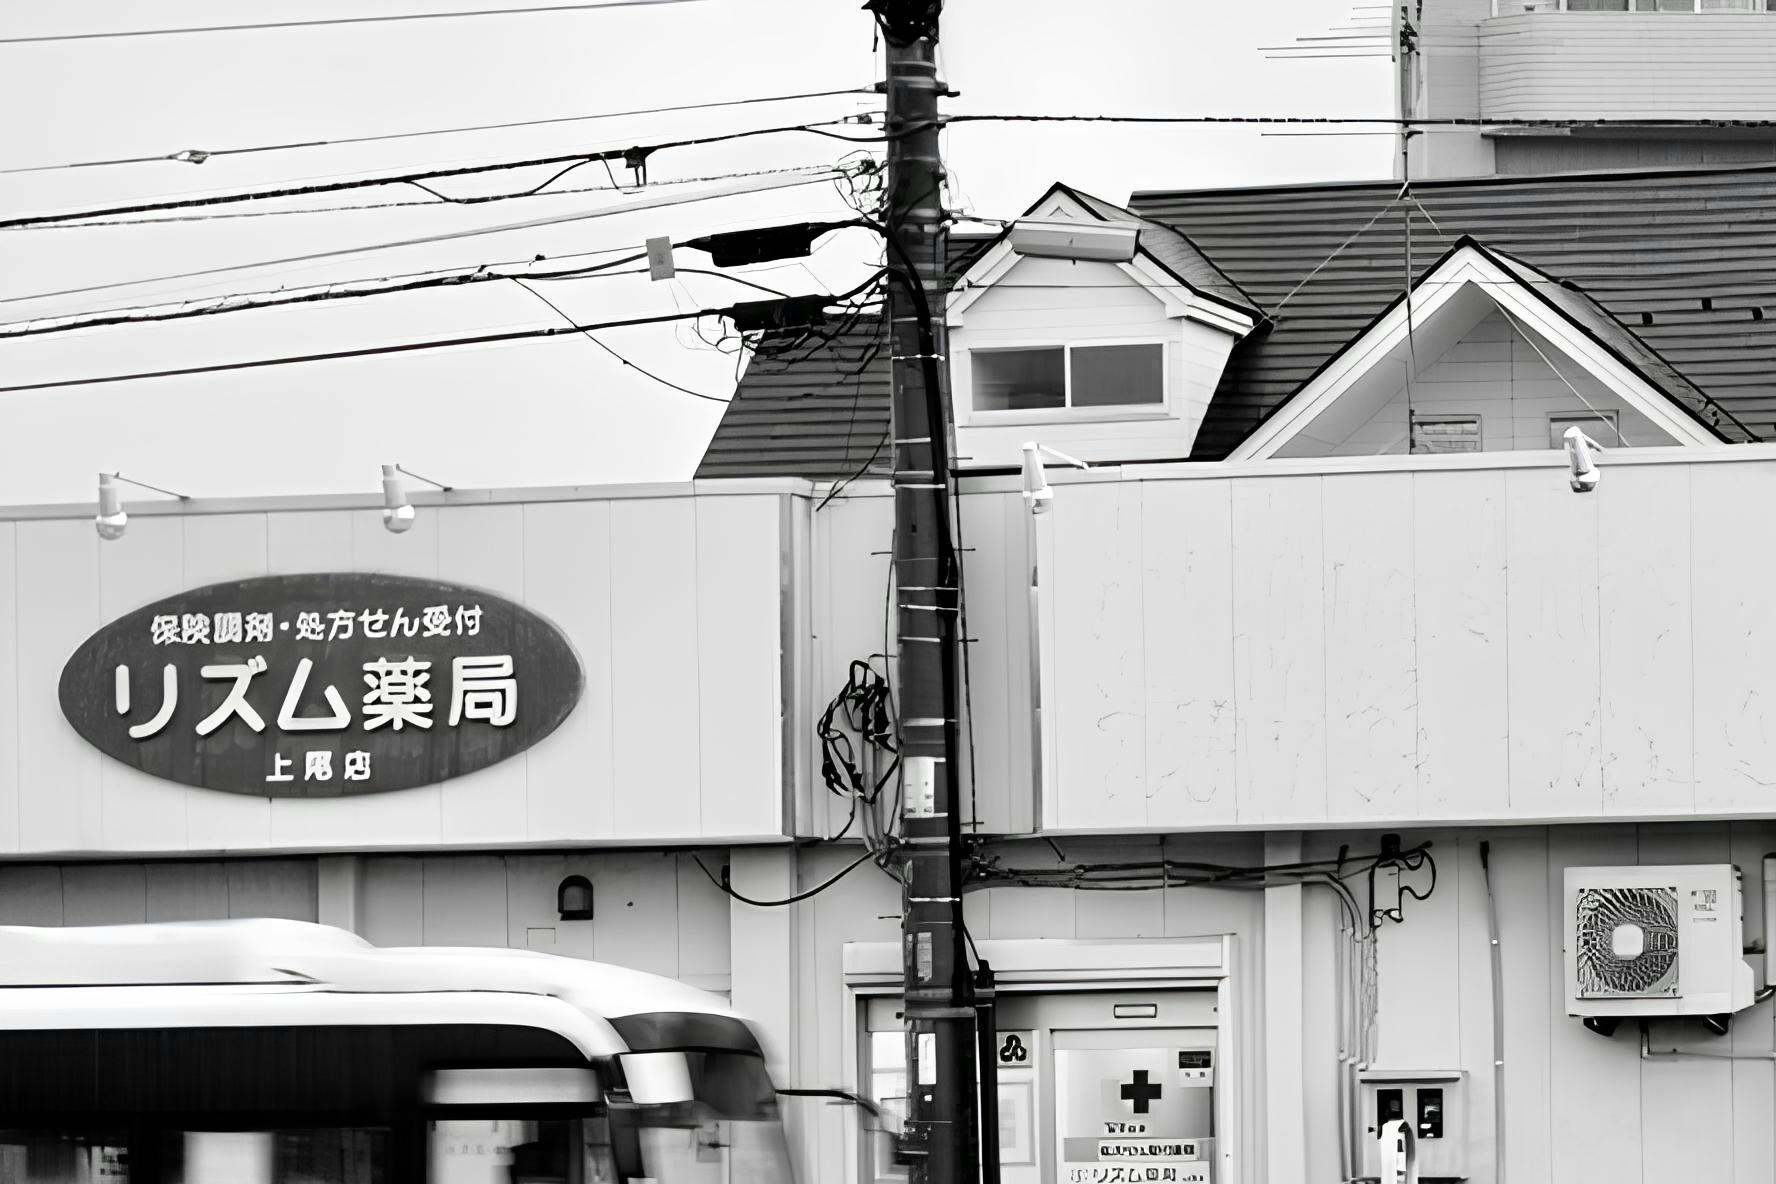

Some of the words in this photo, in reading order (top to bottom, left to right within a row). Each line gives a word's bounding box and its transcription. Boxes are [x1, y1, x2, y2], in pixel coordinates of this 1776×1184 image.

[115, 655, 517, 738] リズム薬局
[265, 750, 371, 781] 上尾店
